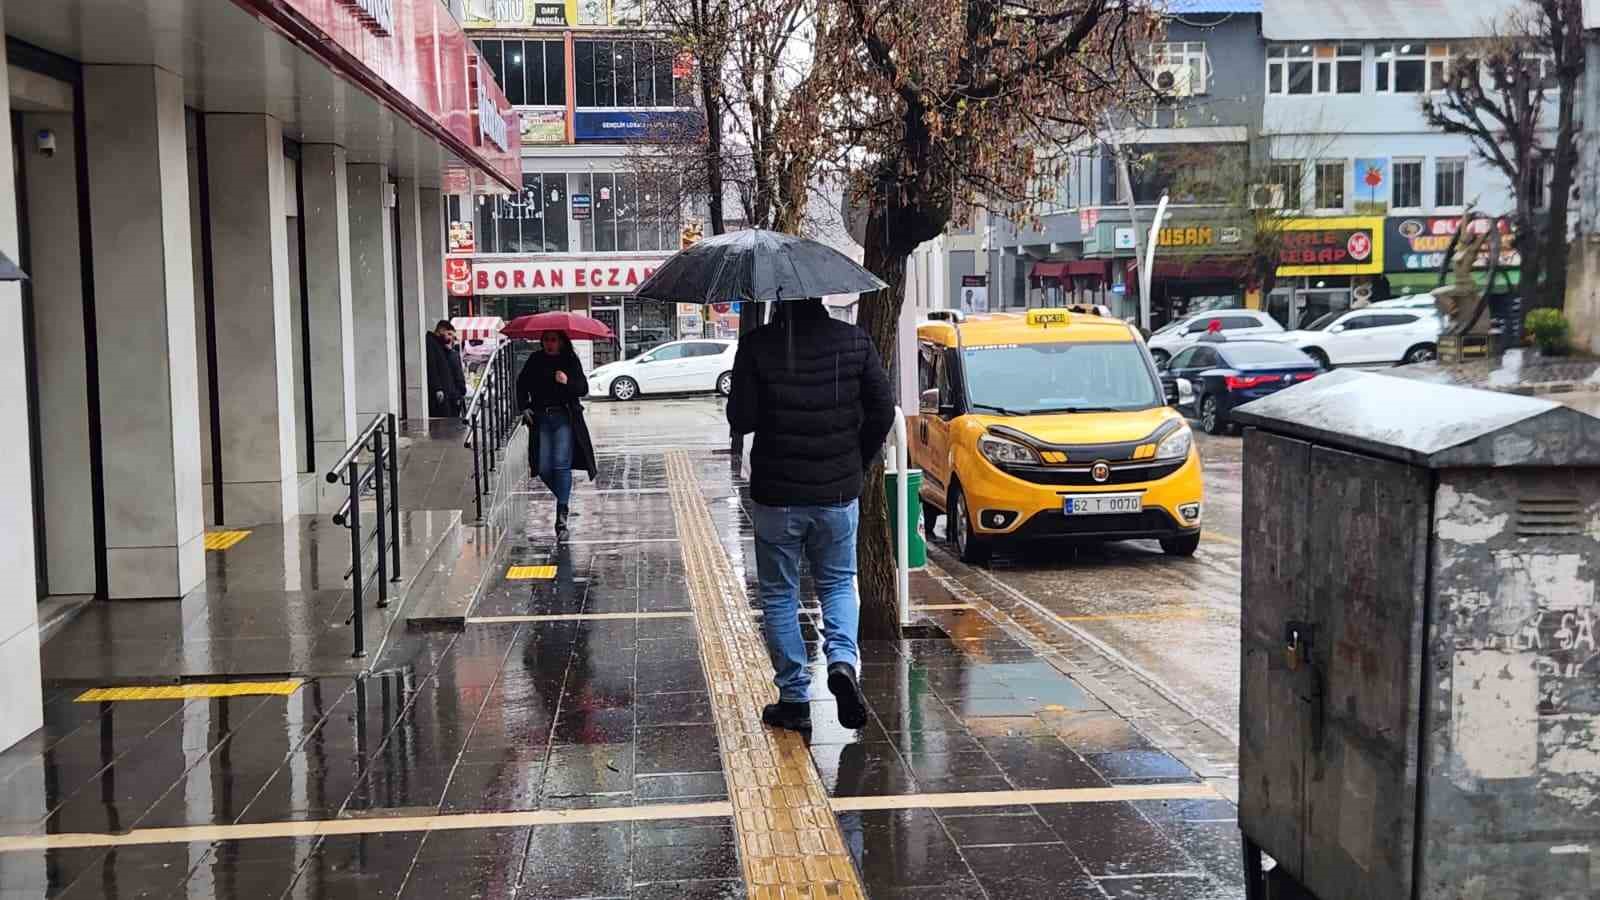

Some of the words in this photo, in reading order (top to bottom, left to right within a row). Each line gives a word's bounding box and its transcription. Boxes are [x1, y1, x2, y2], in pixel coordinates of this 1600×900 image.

[1148, 227, 1214, 246] USAM
[476, 269, 564, 289] BORAN
[1074, 500, 1088, 511] 62
[1095, 499, 1103, 511] T
